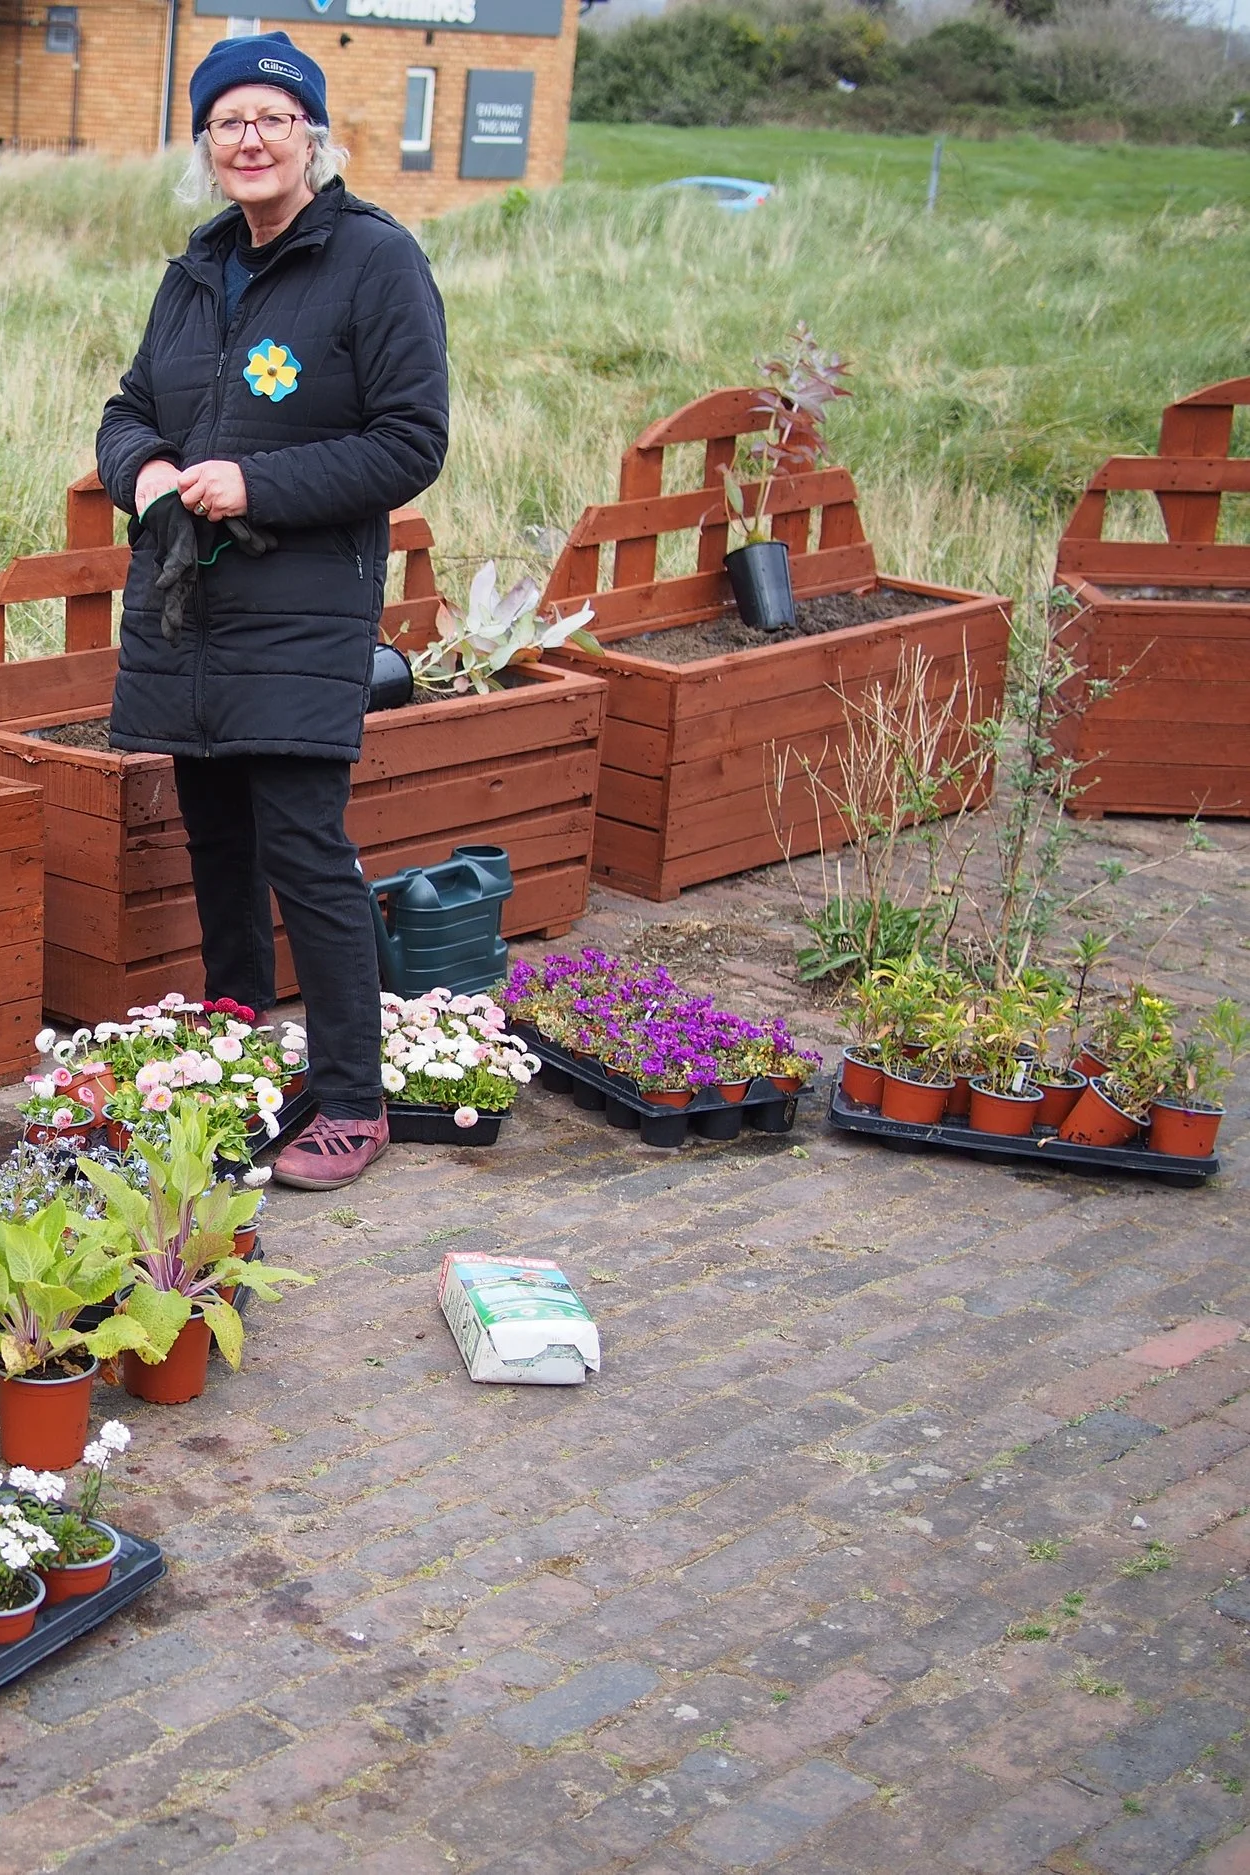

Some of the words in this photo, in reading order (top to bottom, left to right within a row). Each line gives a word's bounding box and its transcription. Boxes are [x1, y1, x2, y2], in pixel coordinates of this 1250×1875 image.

[475, 102, 523, 118] ENTRANCE
[478, 119, 498, 134] THIS
[500, 120, 520, 134] WAY
[453, 1253, 483, 1263] 50%
[486, 1256, 523, 1267] EXTRA
[525, 1259, 557, 1270] FREE
